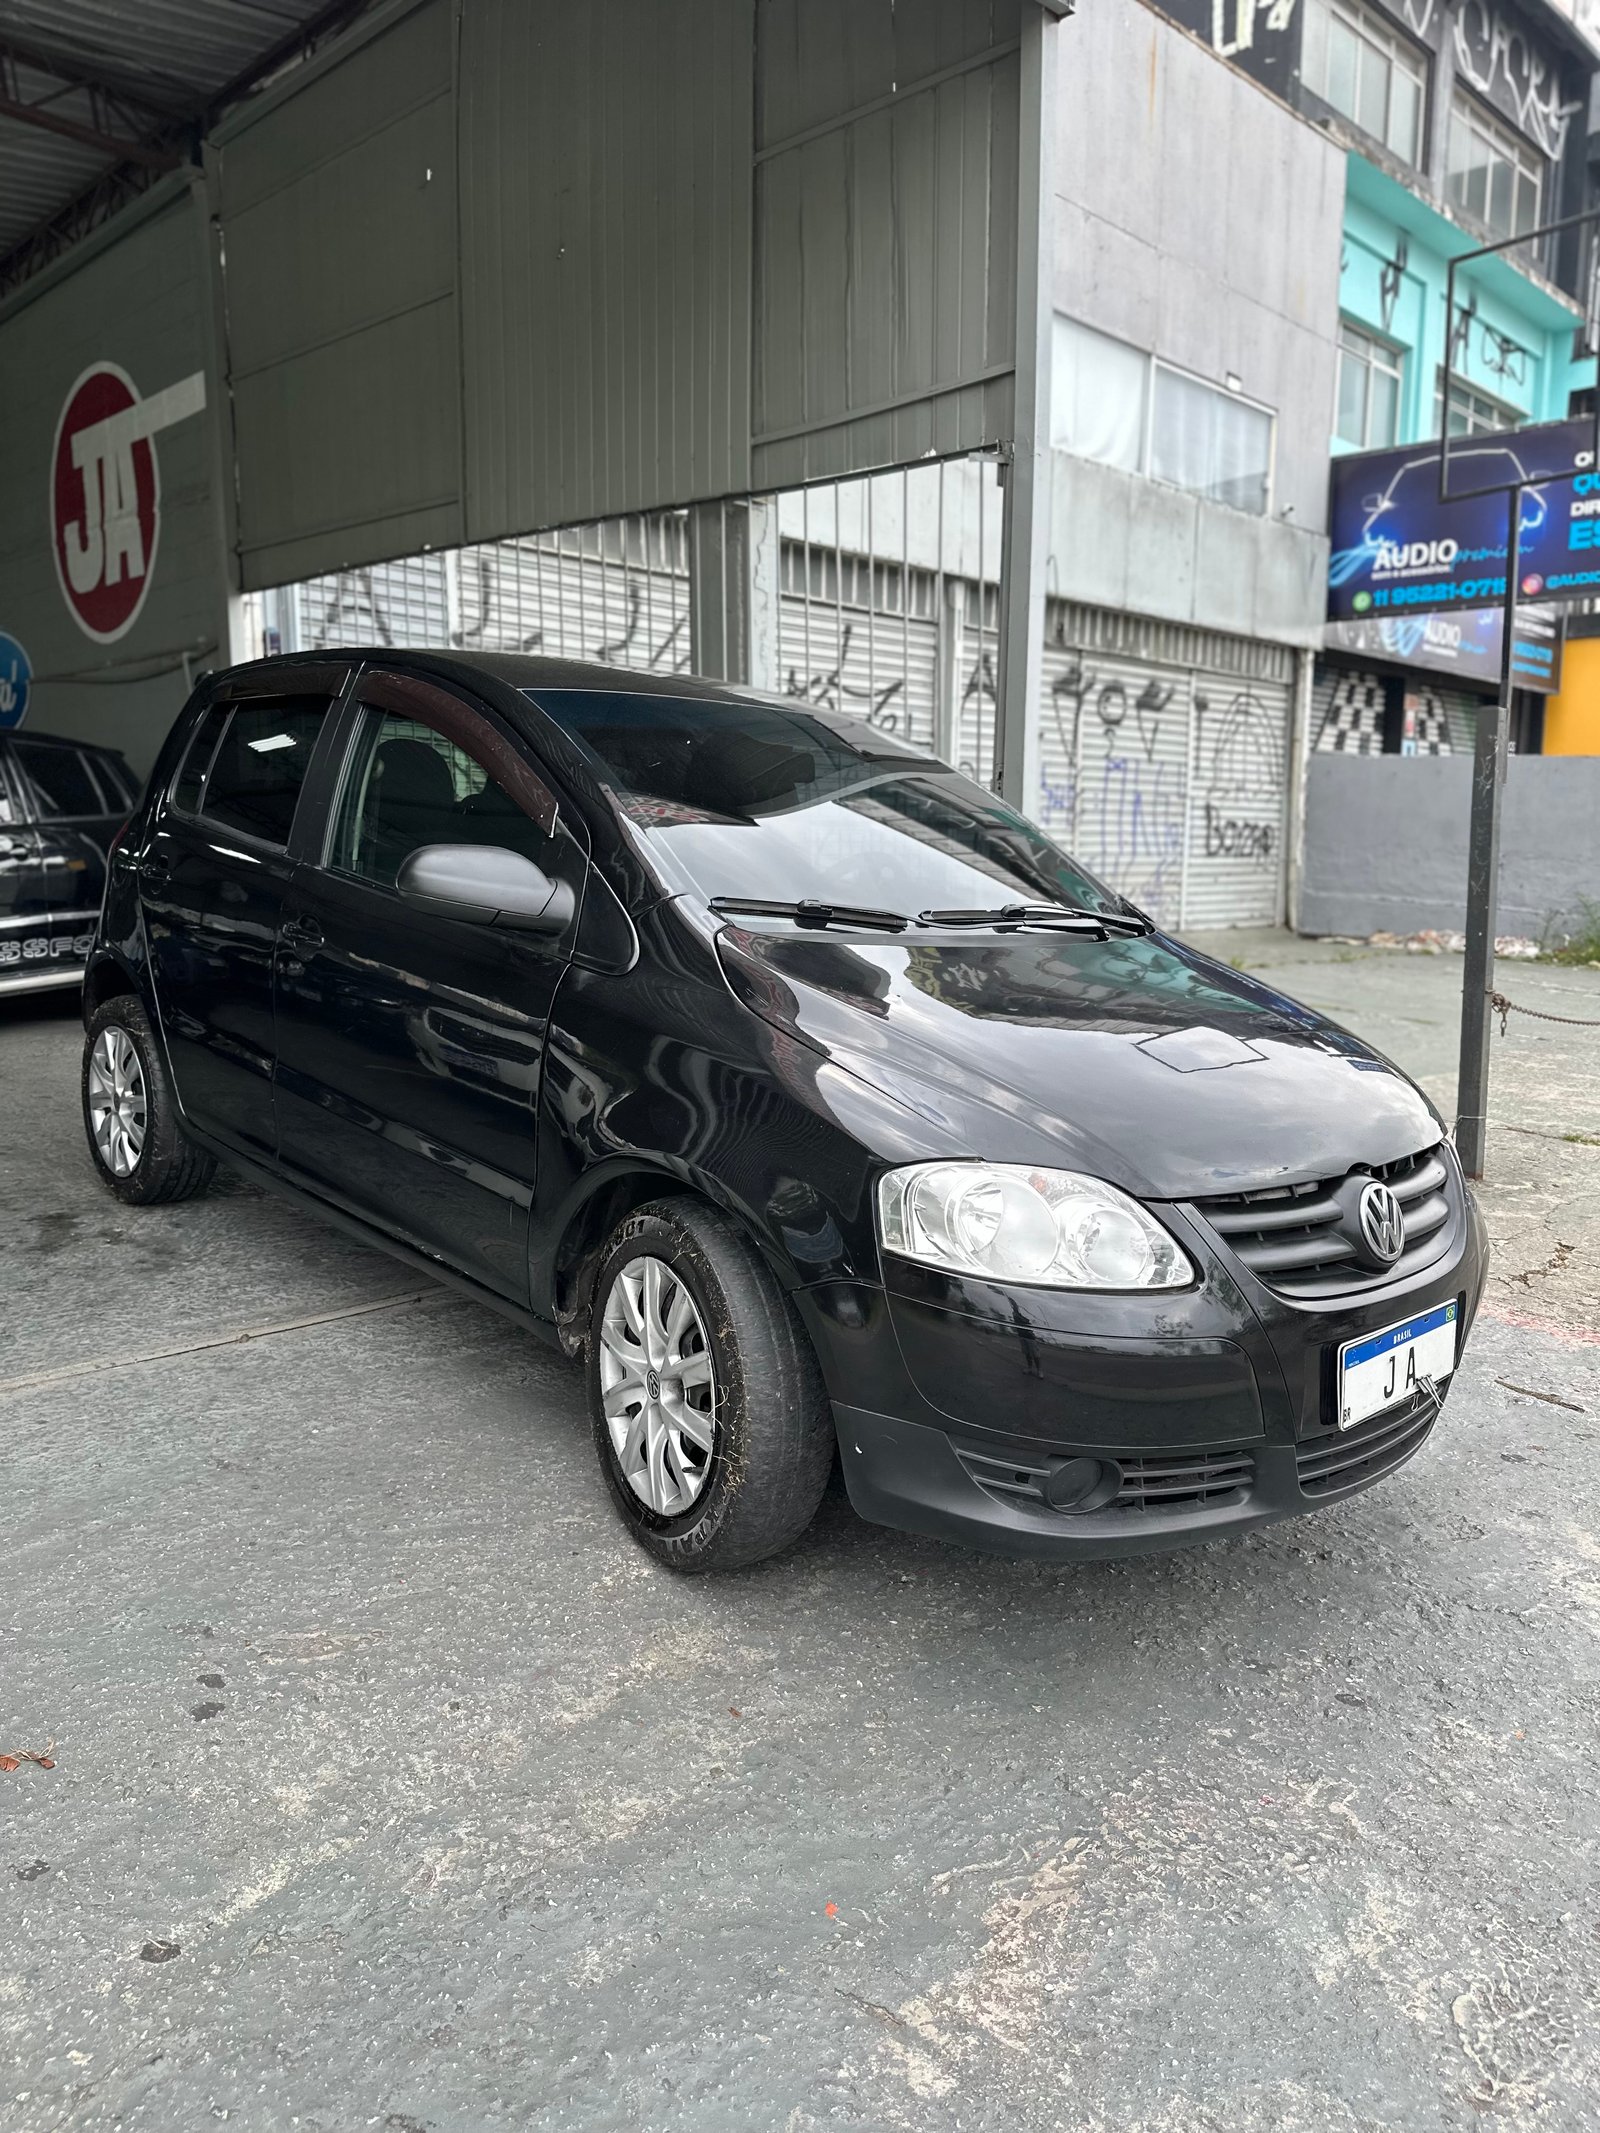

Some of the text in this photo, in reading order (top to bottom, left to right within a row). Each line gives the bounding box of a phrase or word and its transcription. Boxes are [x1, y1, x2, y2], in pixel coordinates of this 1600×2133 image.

[1372, 538, 1459, 571] AUDIO
[1374, 588, 1389, 607] 11
[1393, 1328, 1412, 1345] BRASIL
